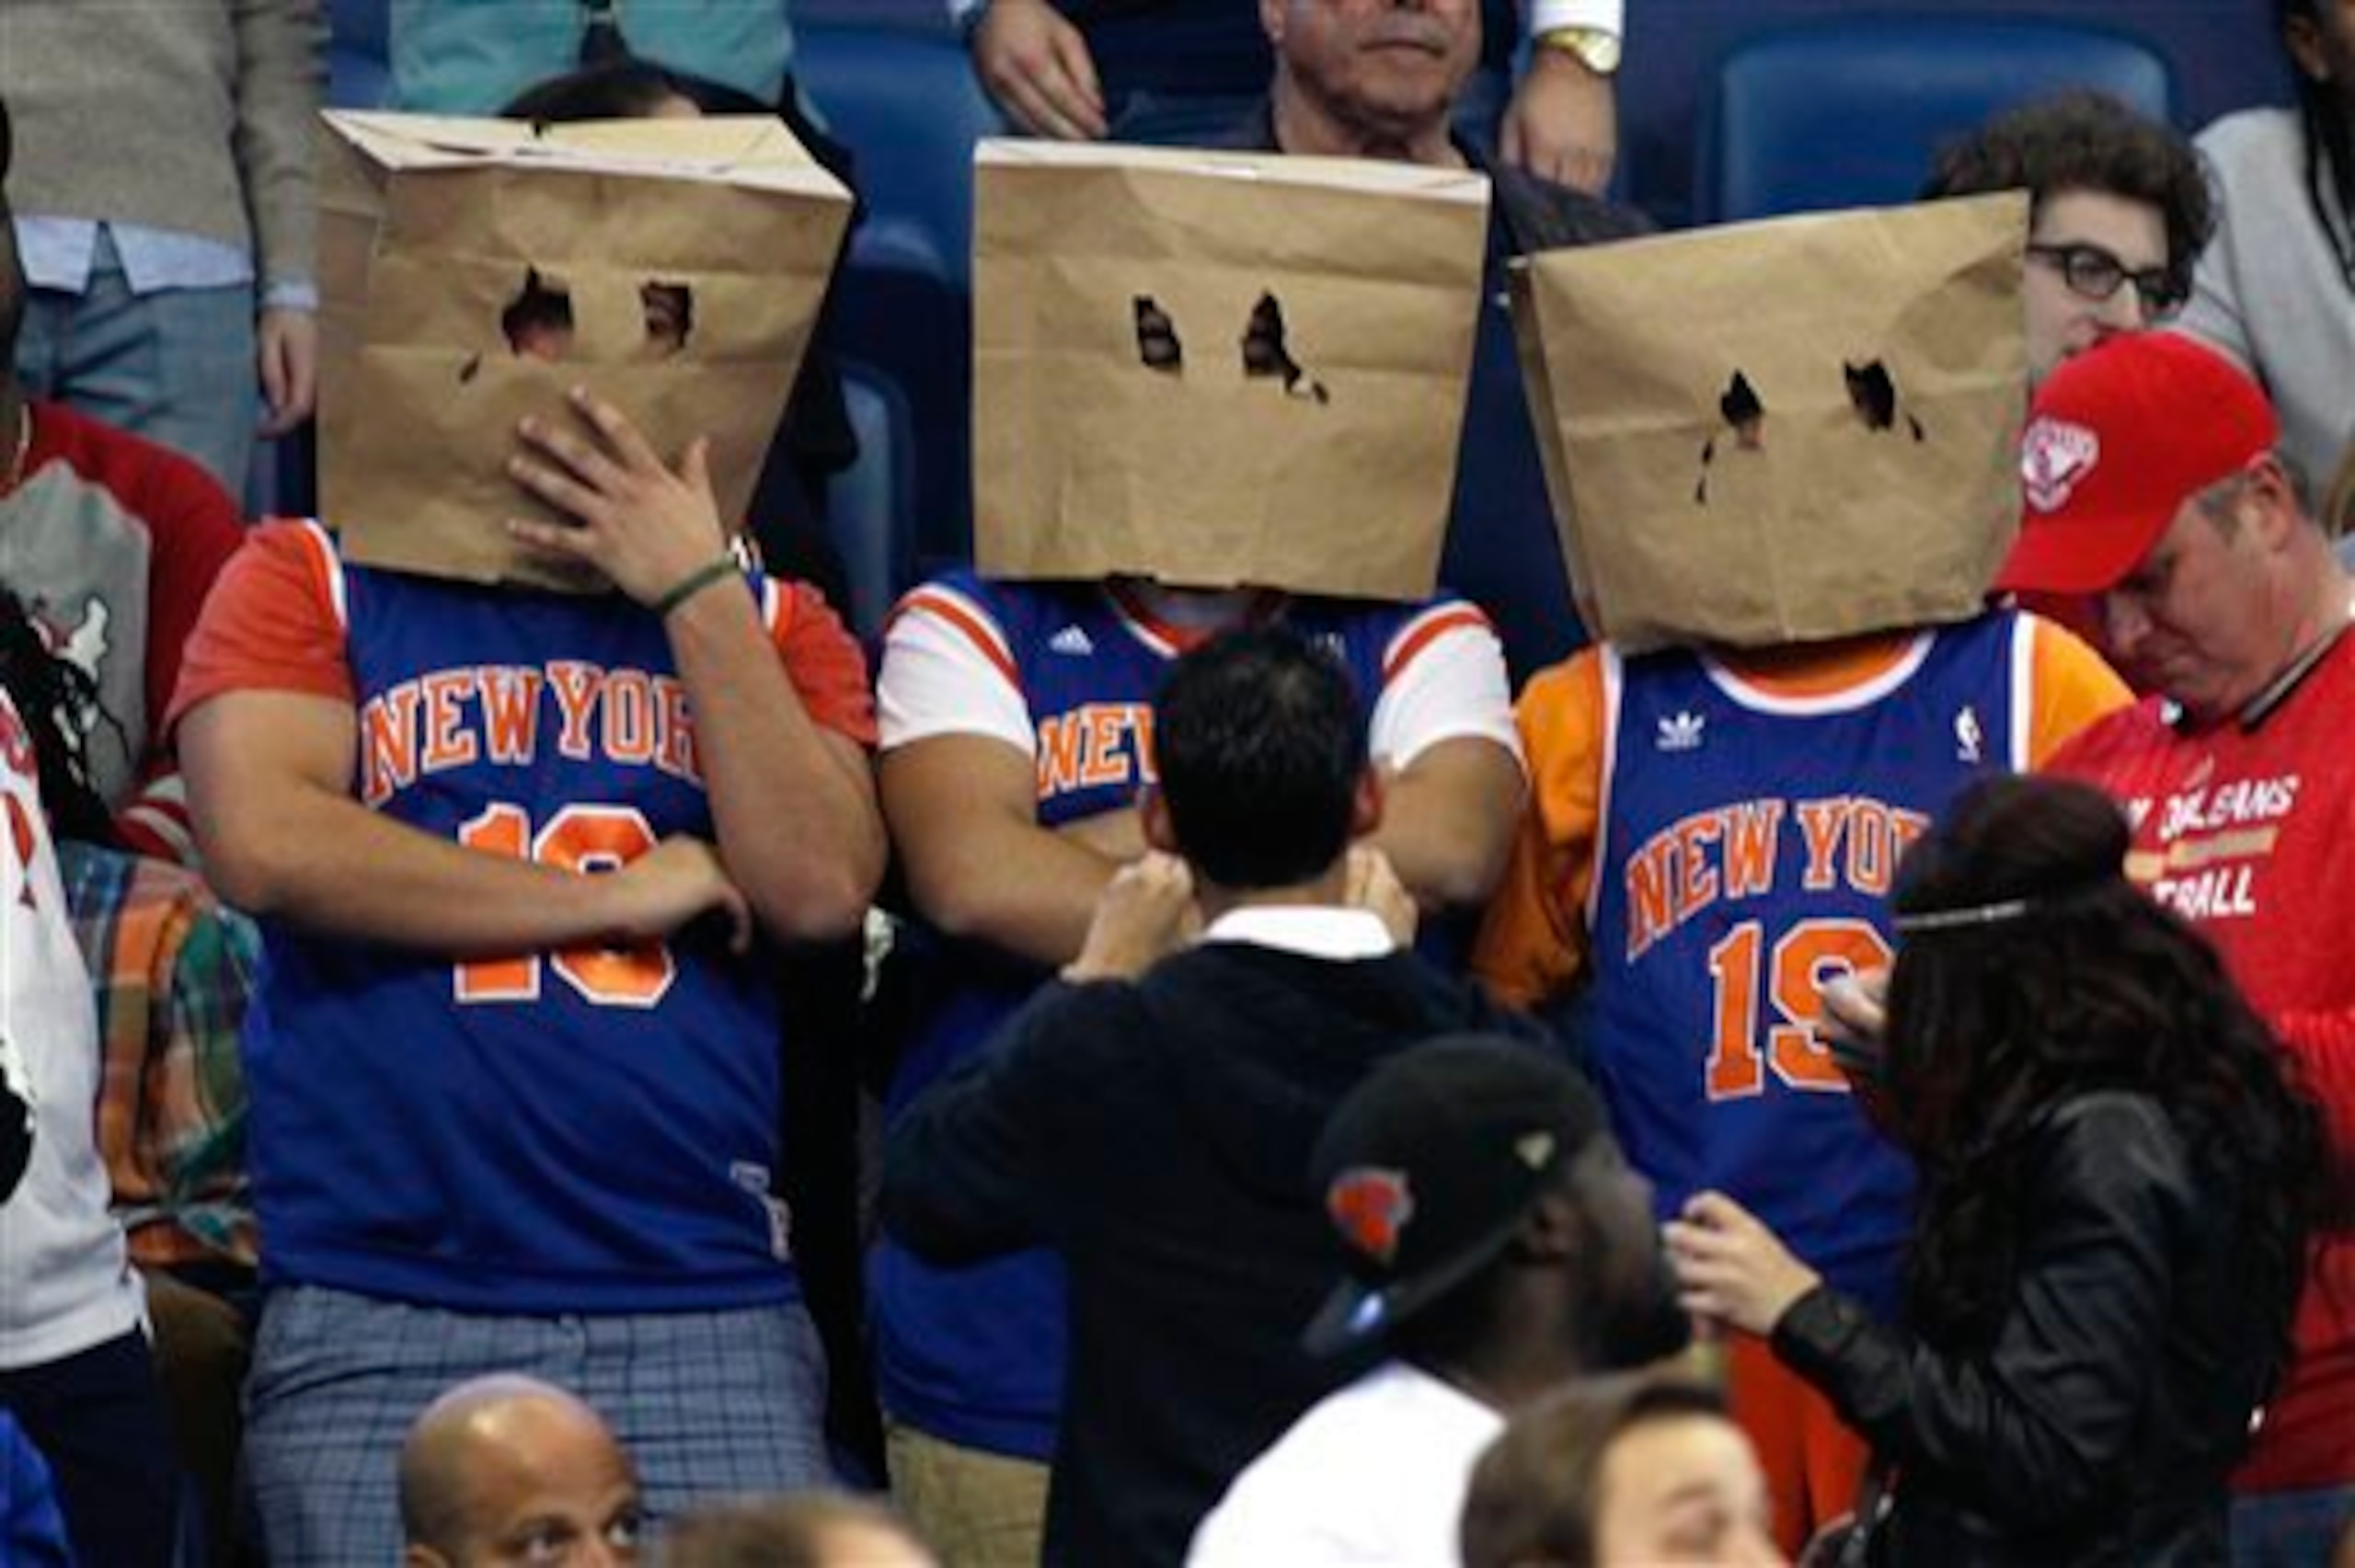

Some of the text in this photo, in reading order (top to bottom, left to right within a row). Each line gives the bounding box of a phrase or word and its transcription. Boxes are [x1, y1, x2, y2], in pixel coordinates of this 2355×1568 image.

[362, 658, 706, 809] NEW YOR
[1624, 794, 1932, 964] NEW YO
